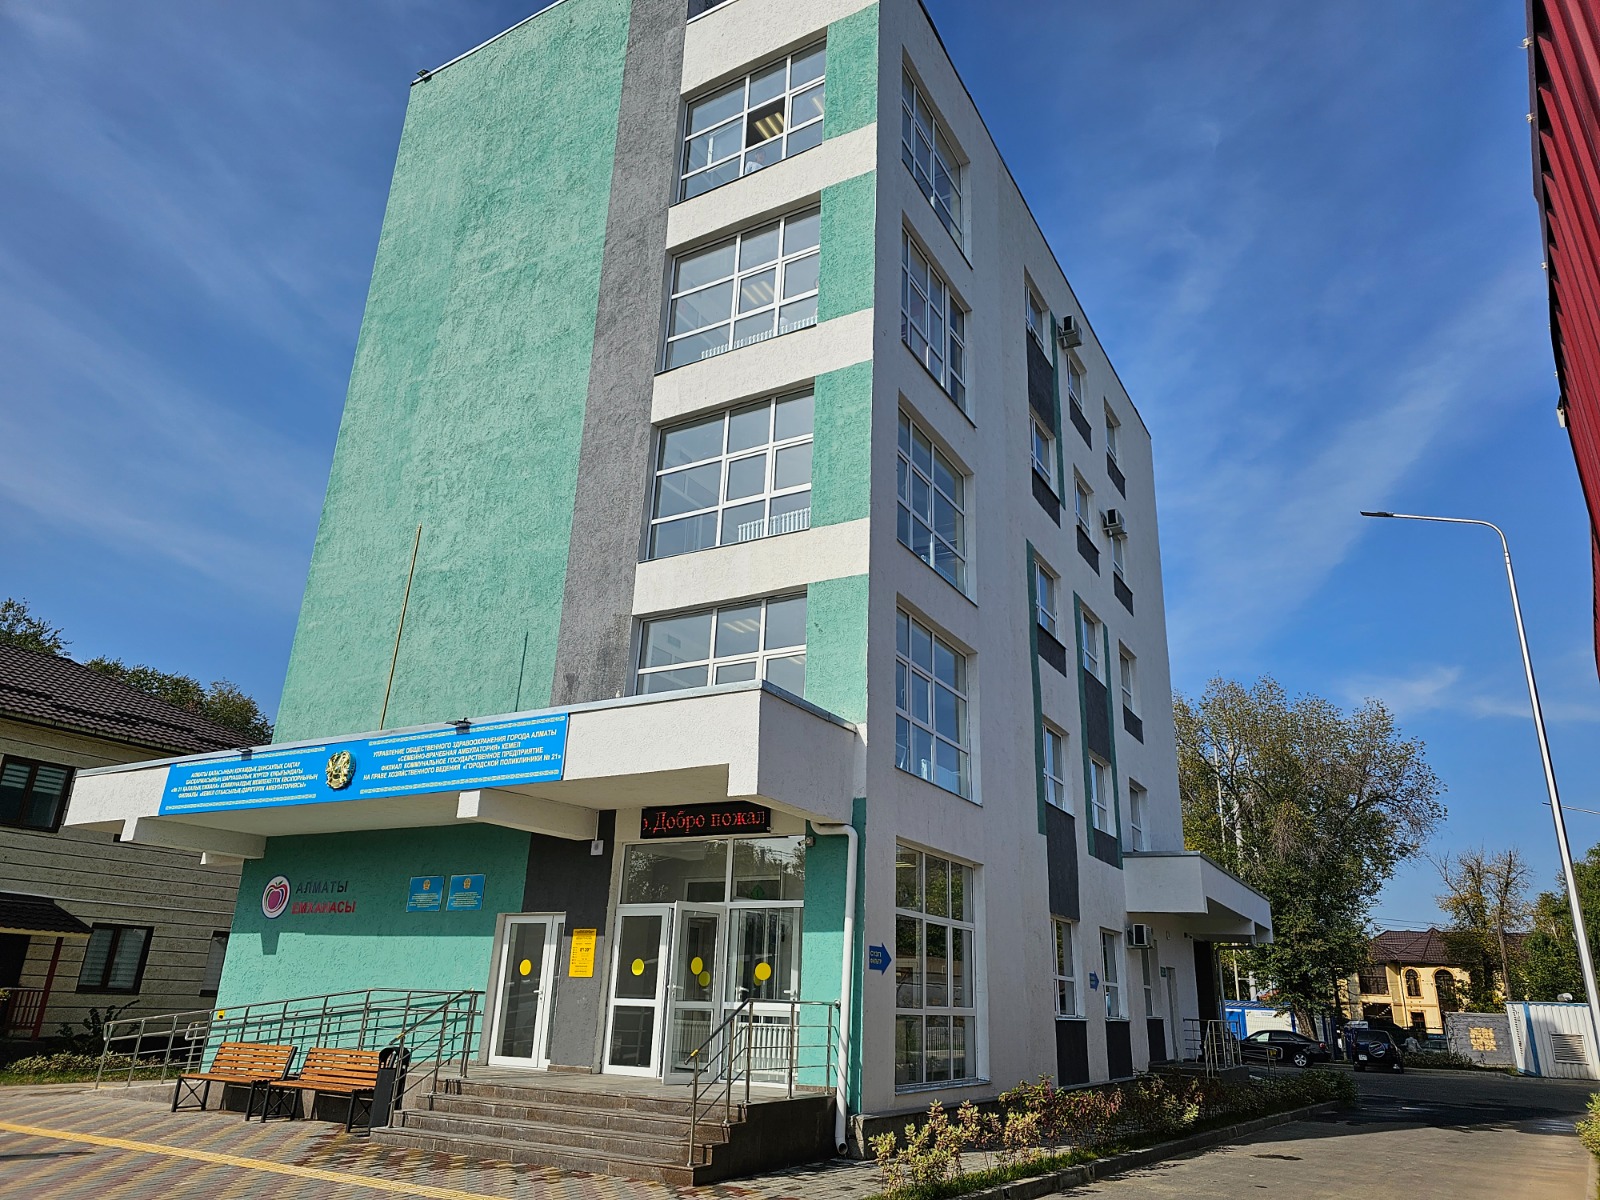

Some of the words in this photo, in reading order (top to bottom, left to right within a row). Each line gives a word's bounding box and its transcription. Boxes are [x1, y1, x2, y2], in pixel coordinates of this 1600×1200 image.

[405, 742, 452, 754] ОБЩЕСТВЕННОГО
[507, 732, 530, 741] ГОРОДА
[531, 729, 557, 738] АЛМАТЫ
[447, 751, 501, 764] ГОСУДАРСТВЕННОЕ
[501, 747, 544, 758] ПРЕДПРИЯТИЕ
[652, 810, 706, 834] Добро
[710, 811, 765, 827] пожал
[295, 881, 349, 894] АЛМАТЫ
[291, 901, 356, 914] ЕМХАНАСЫ
